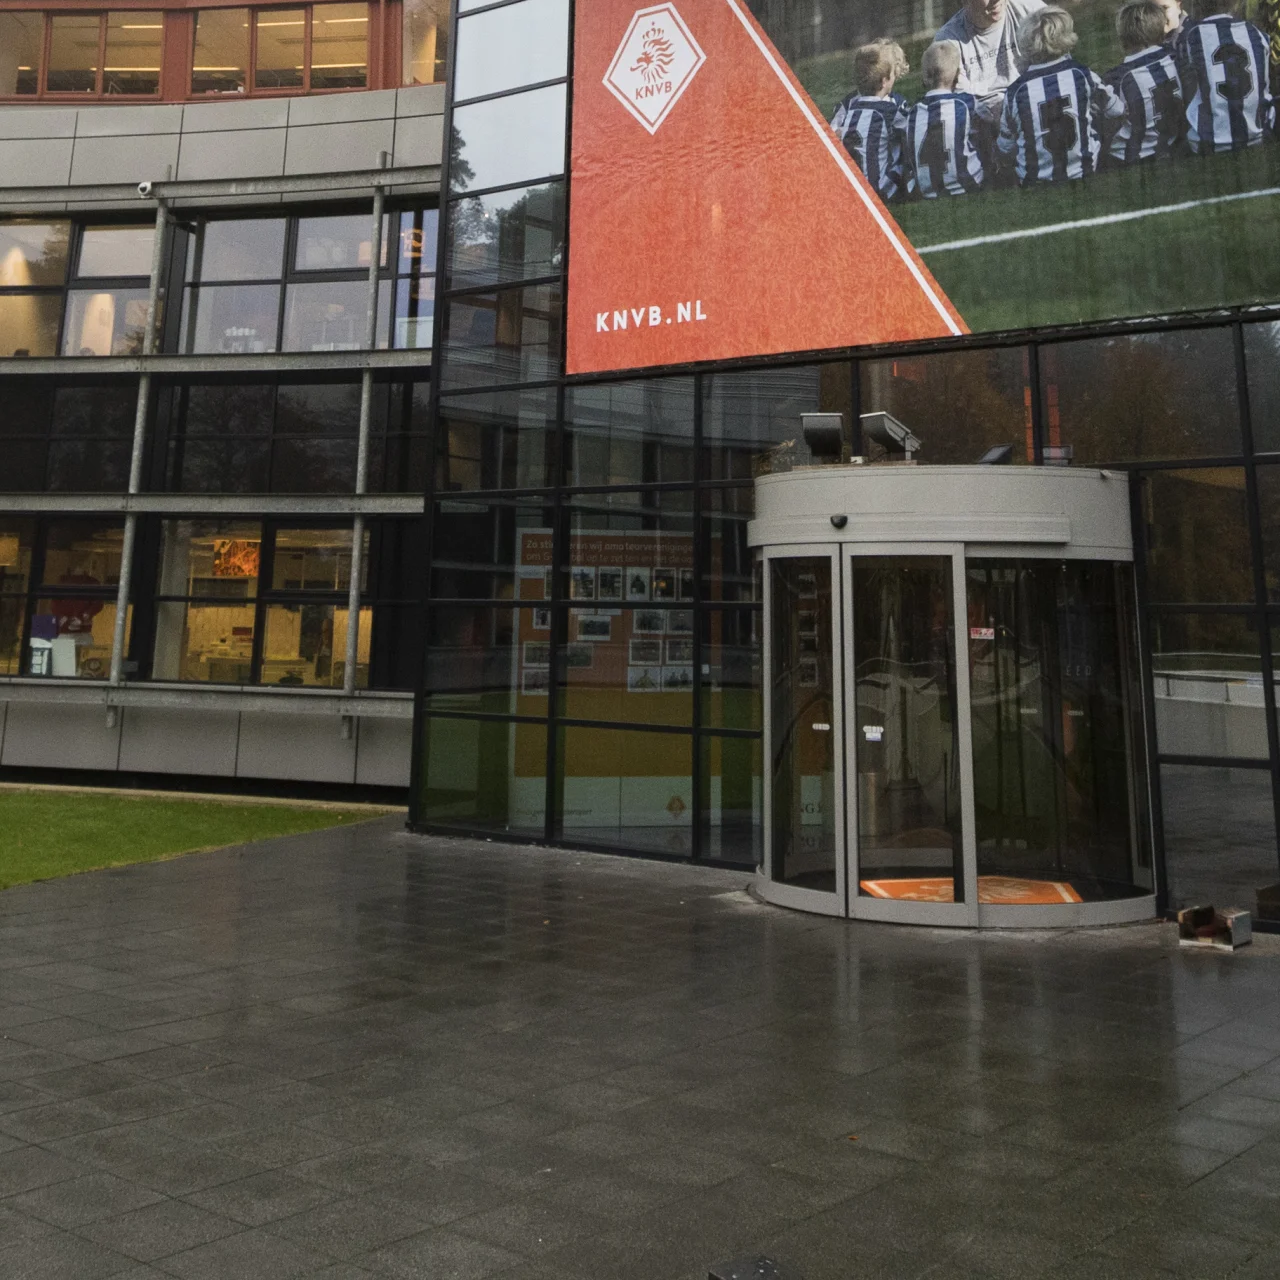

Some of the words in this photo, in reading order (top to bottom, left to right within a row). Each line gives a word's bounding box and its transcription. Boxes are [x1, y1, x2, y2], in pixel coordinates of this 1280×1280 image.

[635, 81, 672, 100] KNVB
[1211, 43, 1255, 101] 3
[916, 120, 951, 175] 4
[1035, 94, 1075, 154] 5
[596, 300, 707, 333] KNVB.NL
